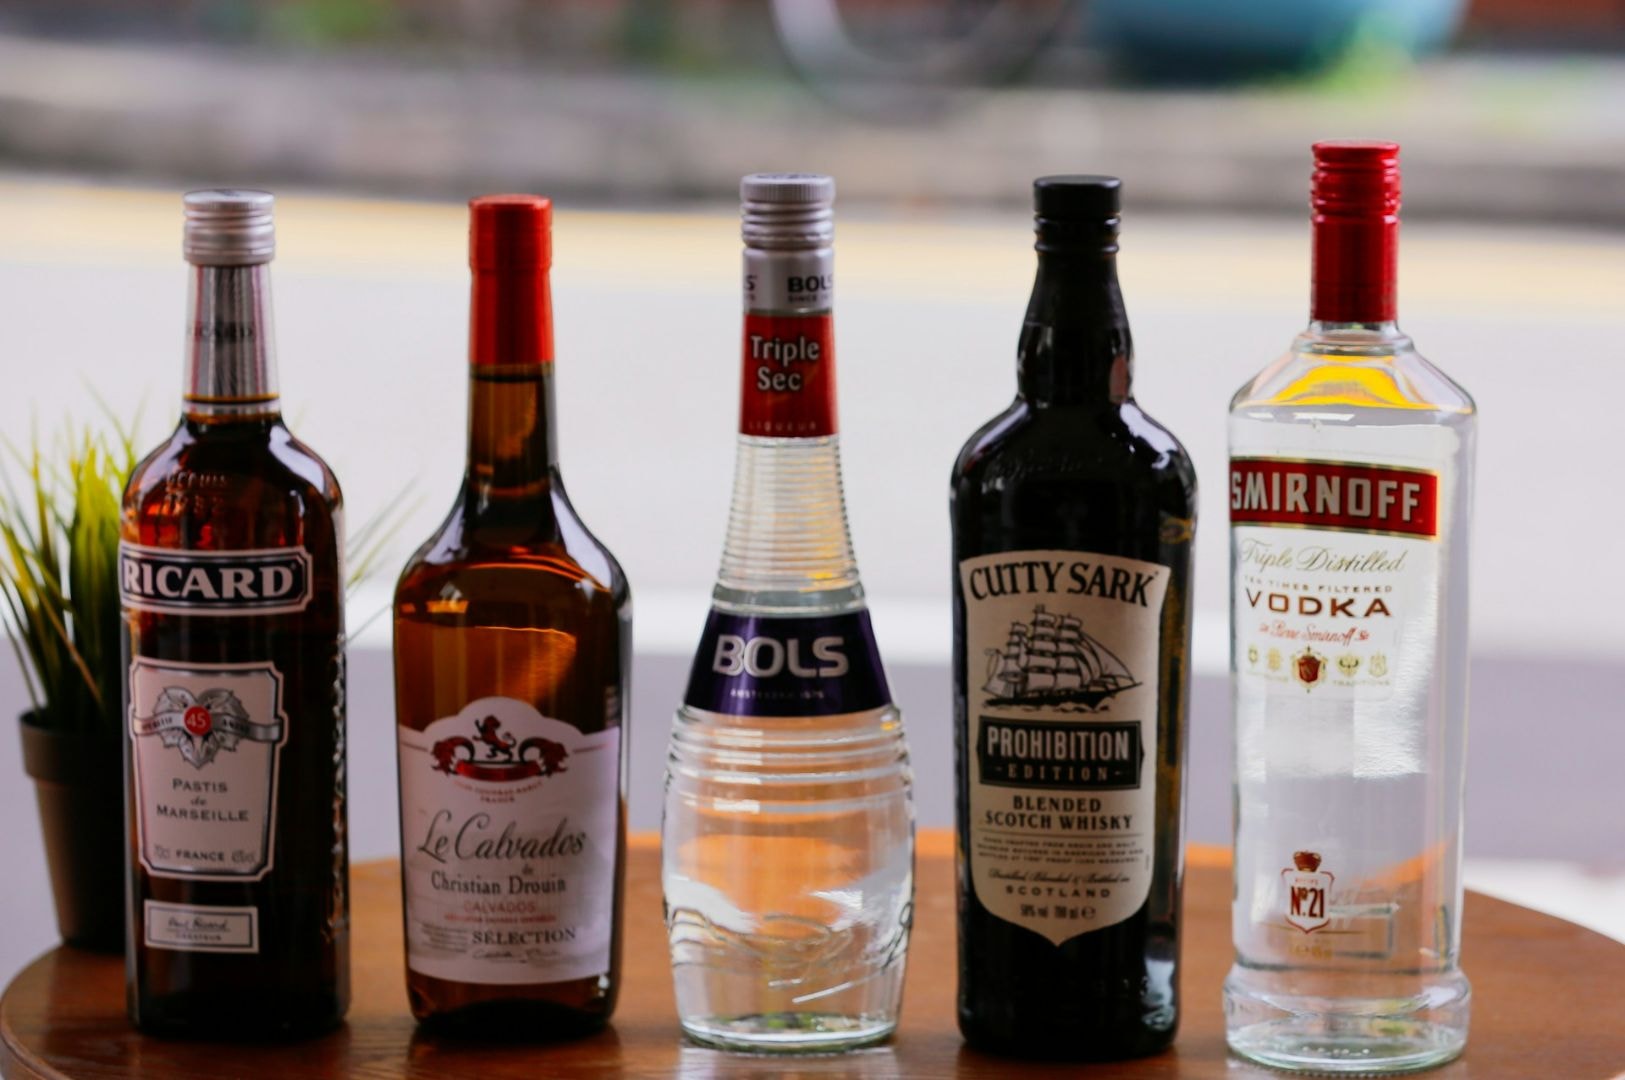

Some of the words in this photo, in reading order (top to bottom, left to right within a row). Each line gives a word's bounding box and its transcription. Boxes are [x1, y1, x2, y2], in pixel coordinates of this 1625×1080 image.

[751, 335, 820, 367] Triple
[757, 366, 801, 391] Sec
[1231, 470, 1421, 522] SMIRNOFF
[1240, 537, 1293, 573] Triple
[1297, 545, 1408, 573] Distilled
[122, 558, 293, 599] RICARD
[969, 561, 1064, 601] CUTTY
[1067, 562, 1154, 608] SARK
[1269, 579, 1309, 591] TIMES
[1318, 584, 1393, 594] FILTERED
[1246, 587, 1392, 618] VODKA
[712, 634, 850, 678] BOLS
[186, 712, 207, 729] 45
[986, 725, 1131, 761] PROHIBITION
[1008, 763, 1109, 781] EDITION
[172, 778, 228, 793] PASTIS
[156, 805, 249, 822] MARSEILLE
[1013, 795, 1102, 812] BLENDED
[985, 810, 1052, 829] SCOTCH
[1059, 815, 1133, 830] WHISKY
[417, 809, 453, 864] Le
[454, 812, 587, 861] Calvados
[175, 850, 225, 862] FRANCE
[431, 871, 501, 894] Christian
[508, 875, 566, 894] Drouin
[1005, 885, 1111, 898] SCOTLAND
[463, 900, 537, 914] CALVADOS
